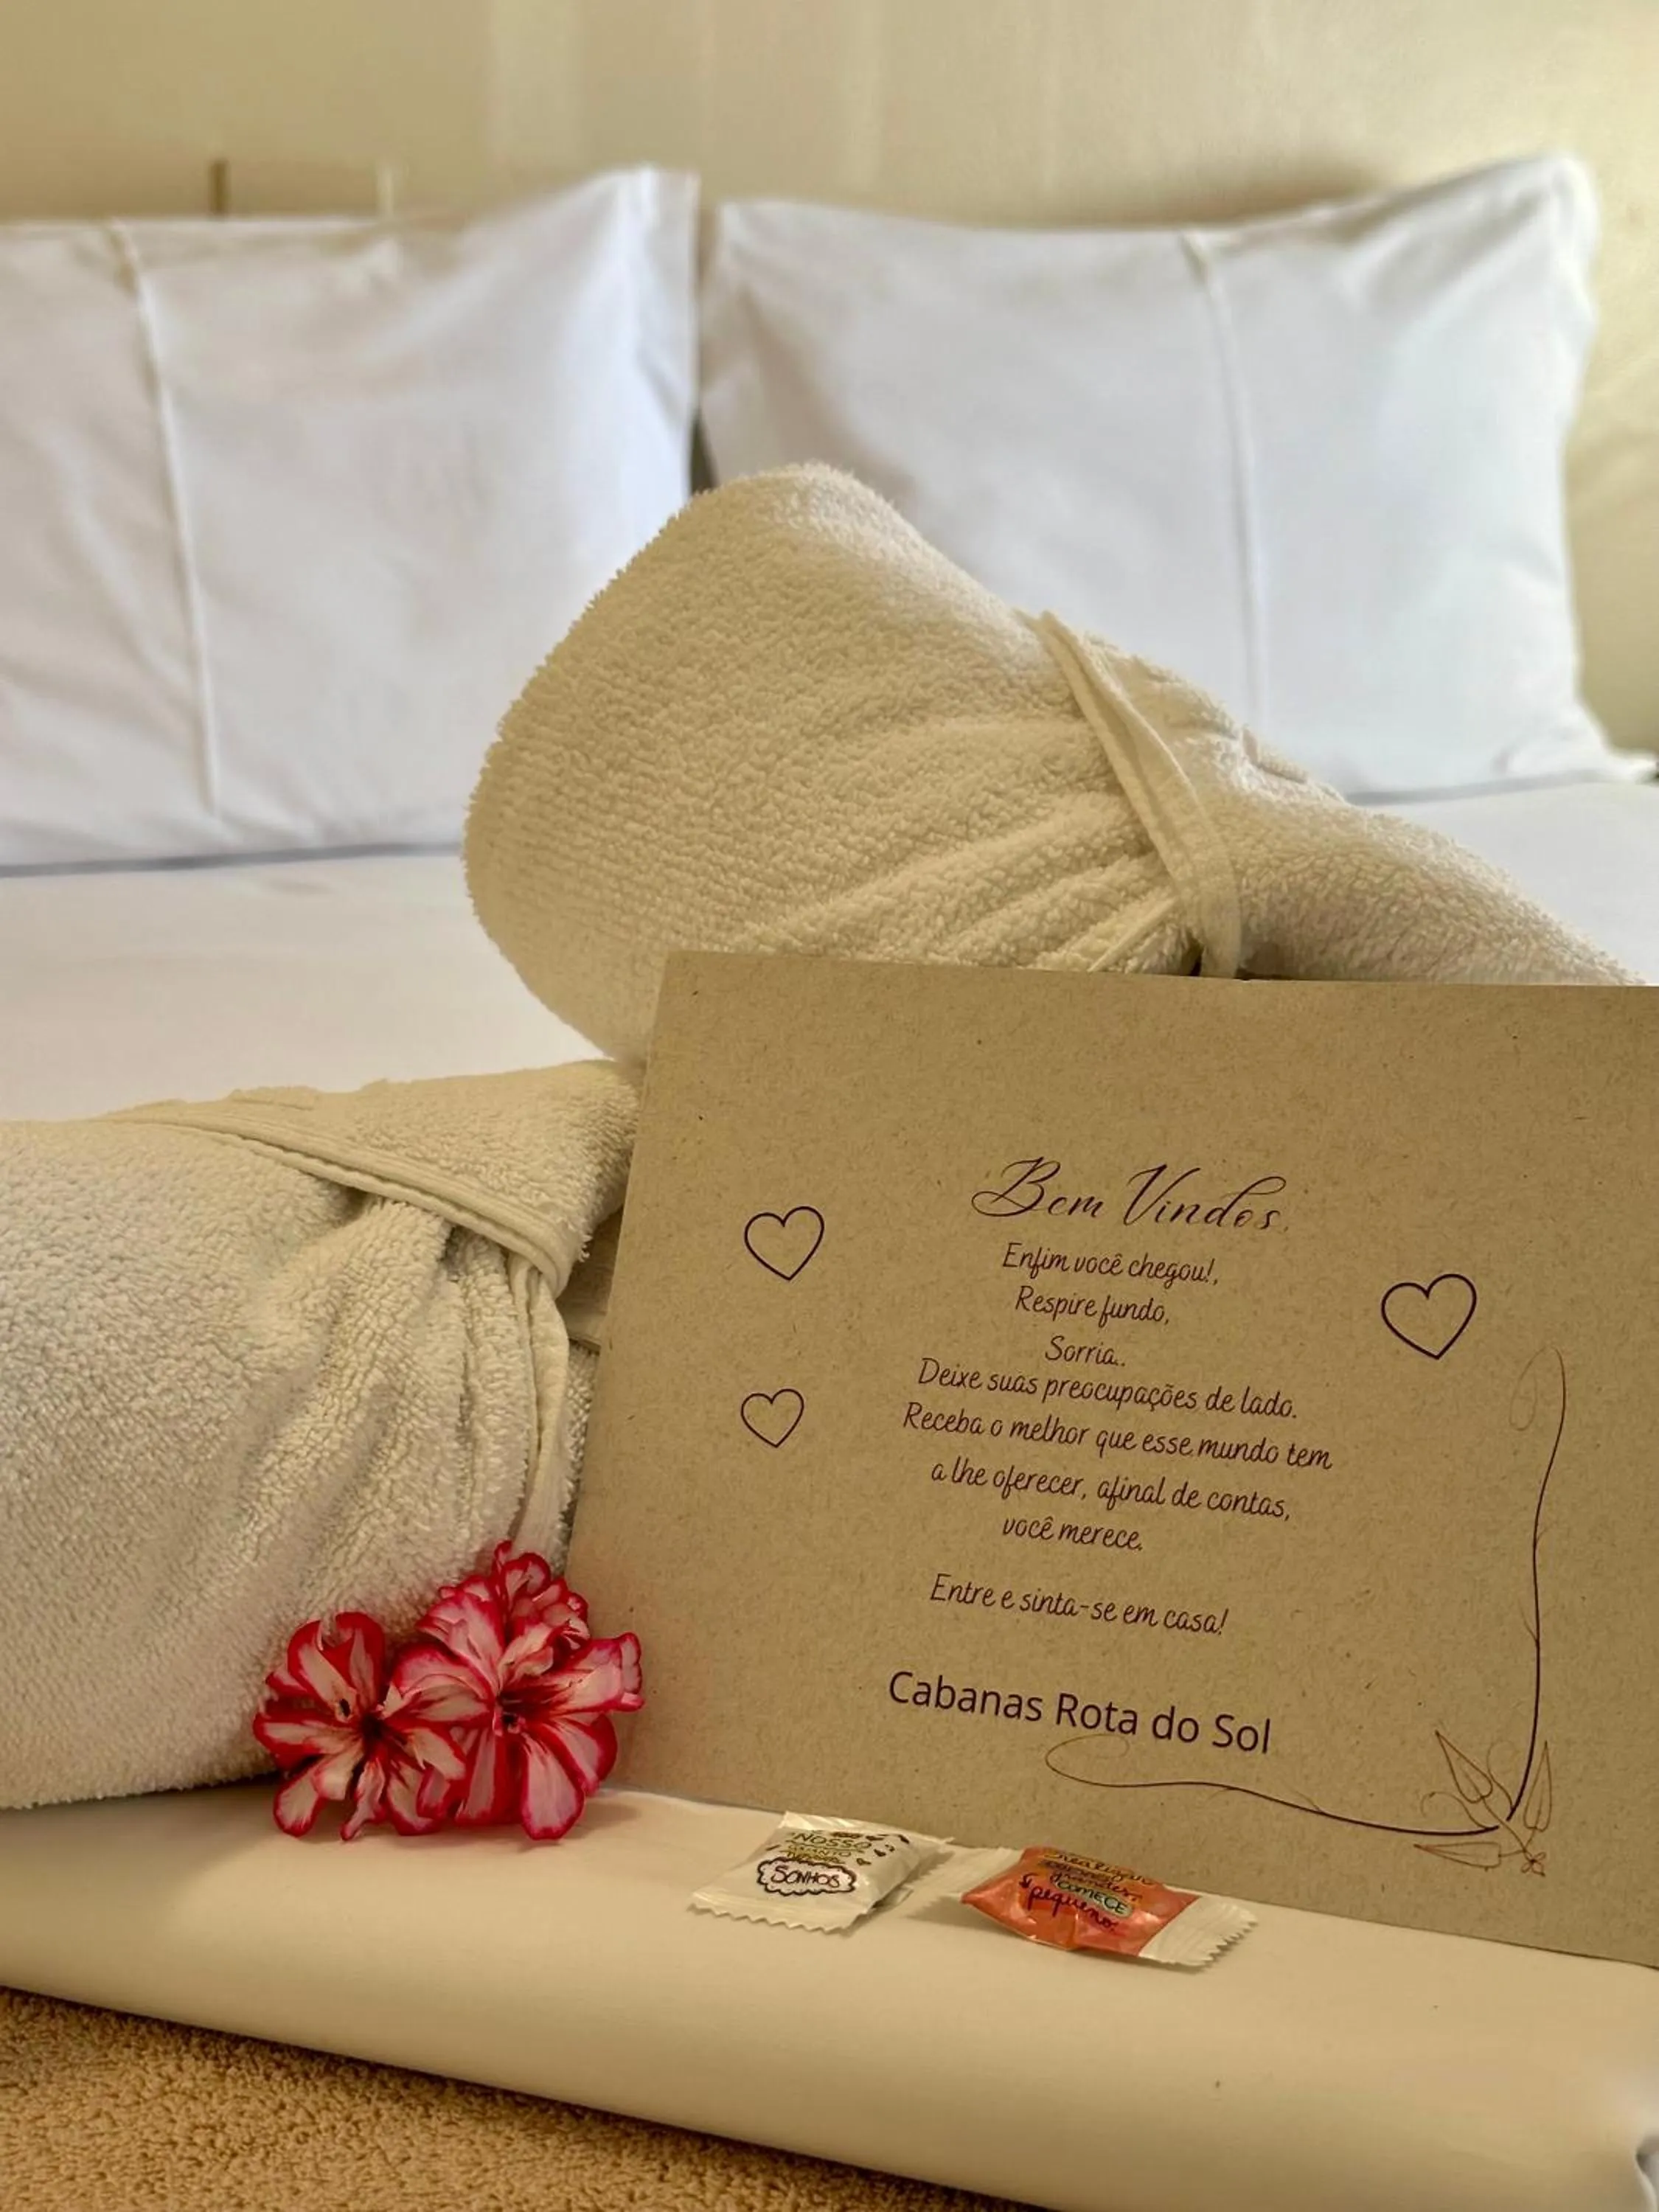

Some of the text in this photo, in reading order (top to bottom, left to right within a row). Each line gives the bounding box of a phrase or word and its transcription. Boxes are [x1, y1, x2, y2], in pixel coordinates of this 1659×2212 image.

[970, 1156, 1105, 1219] Bem
[1002, 1242, 1071, 1280] Enfim
[1073, 1253, 1124, 1277] você
[1015, 1284, 1169, 1329] Respire fundo,
[917, 1357, 1297, 1419] Deixe suas preocupações de lado.
[902, 1401, 1333, 1470] Receba o melhor que esse mundo tem
[931, 1455, 1290, 1522] a lhe oferecer, afinal de contas,
[1002, 1515, 1143, 1551] você merece.
[929, 1573, 1229, 1636] Entre e sinta-se em casa!
[888, 1671, 1271, 1755] Cabanas Rota do Sol
[794, 1832, 872, 1849] NOSSO
[771, 1865, 840, 1888] SONHOS
